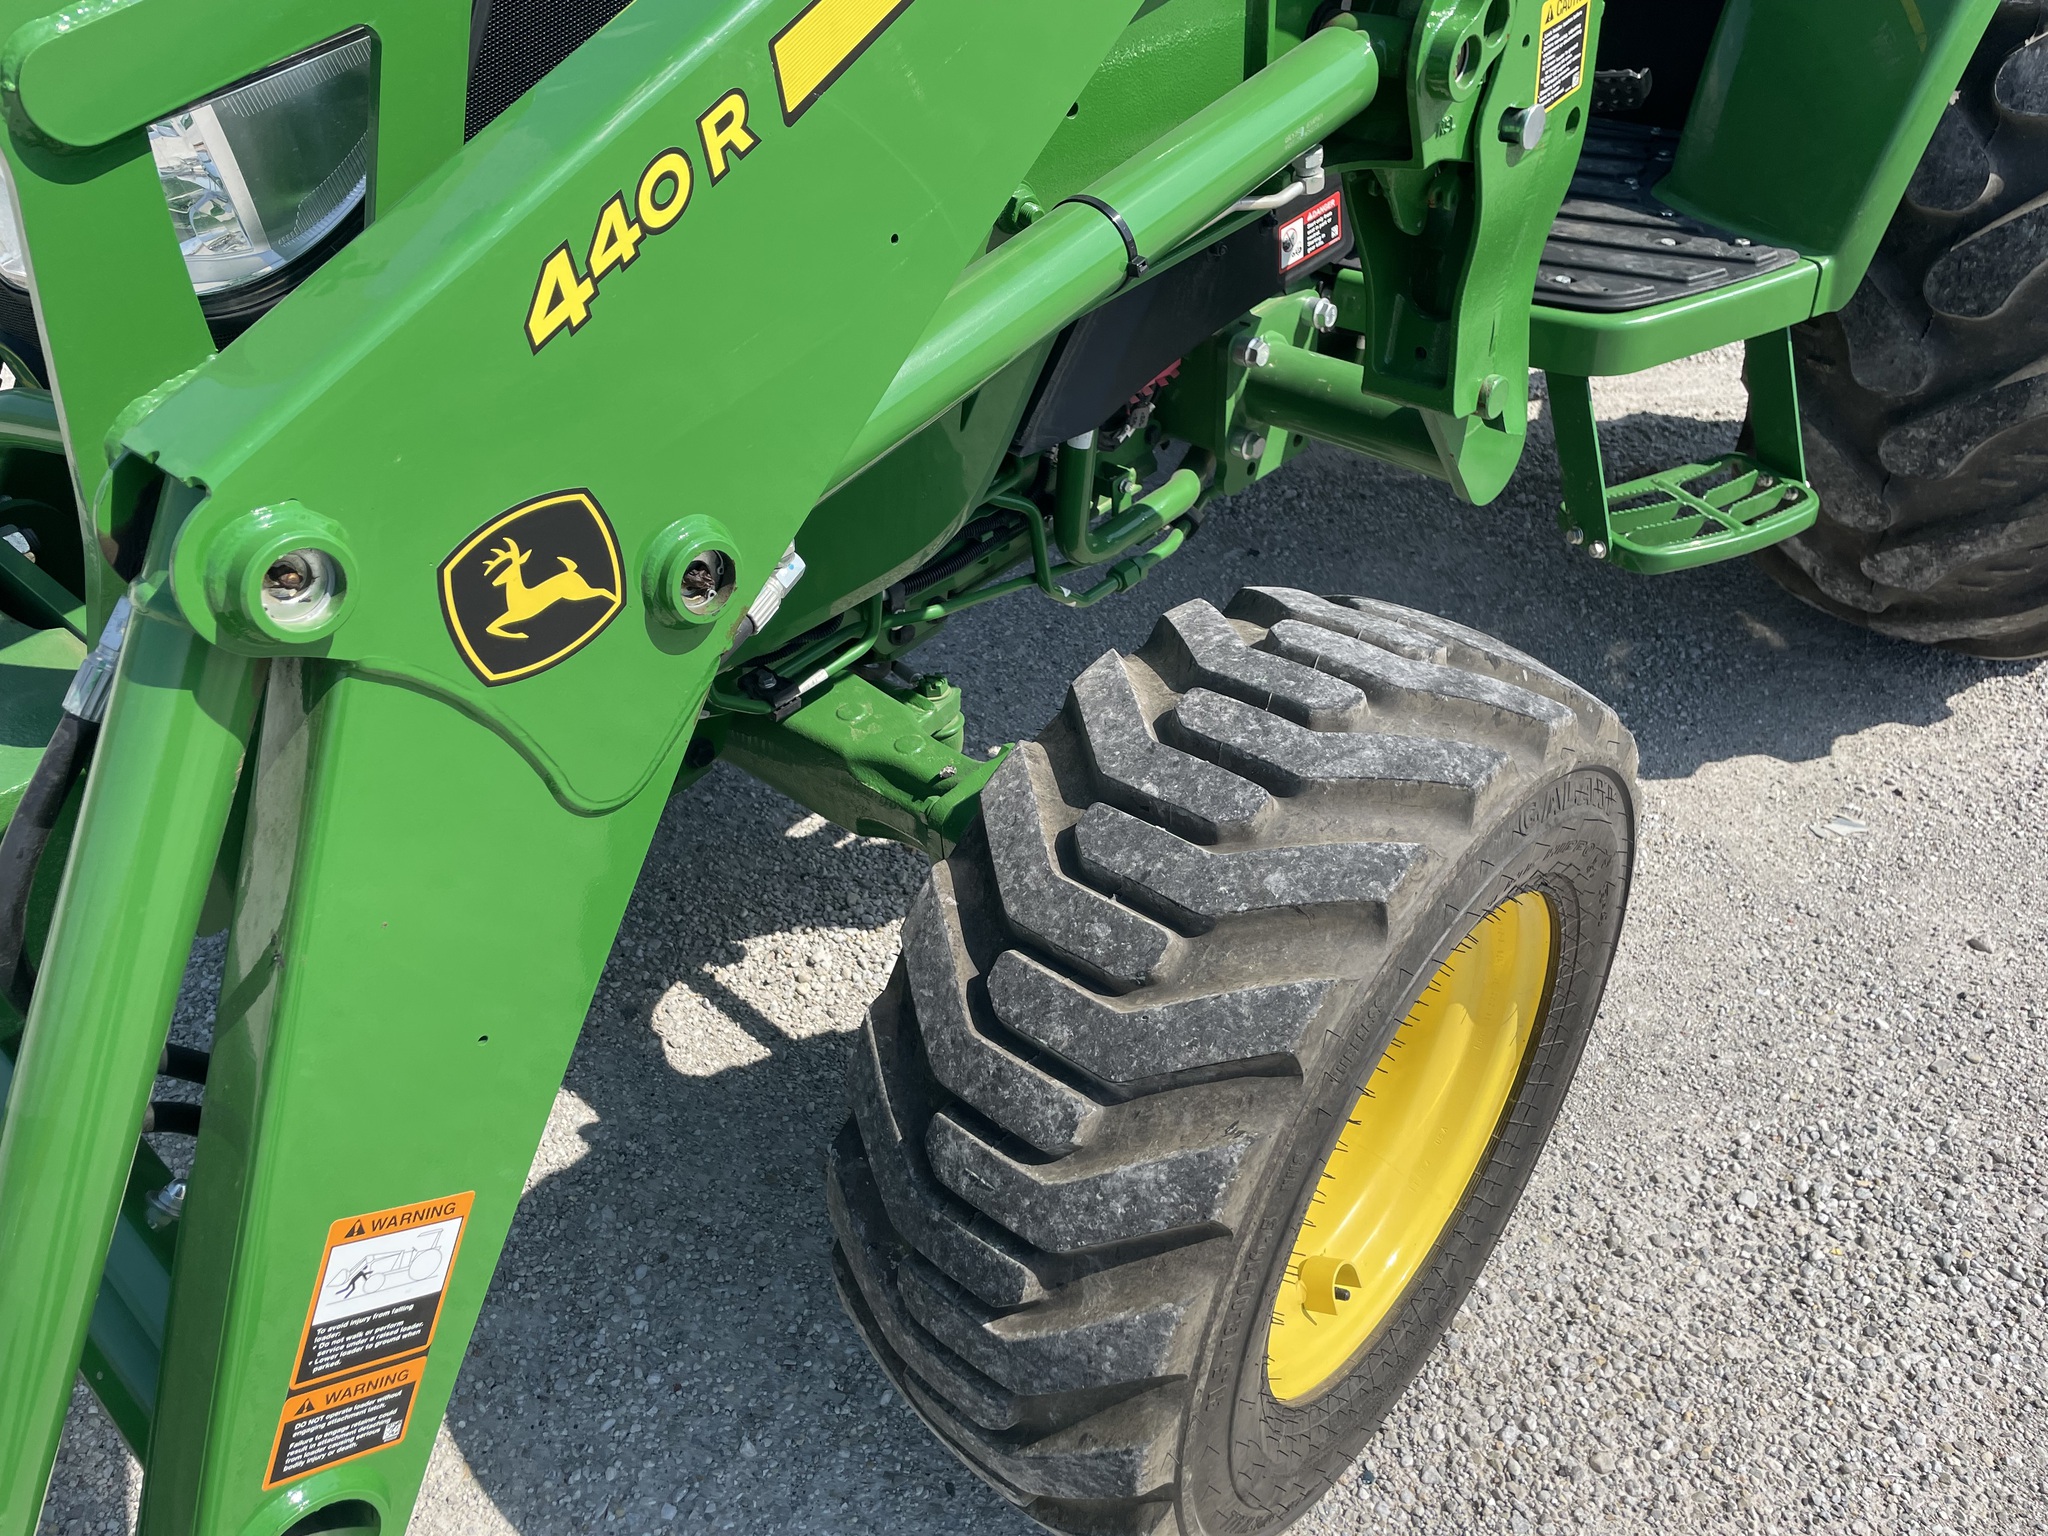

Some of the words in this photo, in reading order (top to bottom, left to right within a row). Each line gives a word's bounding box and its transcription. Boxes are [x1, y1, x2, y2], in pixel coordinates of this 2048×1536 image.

[371, 1202, 456, 1232] WARNING
[316, 1328, 325, 1336] To
[327, 1321, 349, 1333] avoid
[350, 1315, 371, 1327] injury
[372, 1310, 390, 1320] from
[391, 1304, 415, 1315] falling
[318, 1342, 330, 1350] Do
[331, 1336, 345, 1346] not
[345, 1331, 364, 1342] walk
[365, 1328, 374, 1336] or
[374, 1320, 404, 1335] perform
[314, 1353, 338, 1365] Lower
[339, 1346, 365, 1358] loader
[365, 1341, 374, 1350] to
[374, 1334, 401, 1349] ground
[402, 1329, 422, 1340] when
[316, 1345, 345, 1357] service
[346, 1337, 369, 1348] under
[375, 1329, 399, 1340] raised
[311, 1359, 342, 1374] parked.
[325, 1369, 409, 1405] WARNING
[292, 1423, 326, 1438] engaging
[326, 1408, 367, 1427] attachment
[294, 1420, 307, 1431] DO
[308, 1414, 326, 1426] NOT
[325, 1406, 353, 1420] operate
[353, 1398, 376, 1411] loader
[376, 1389, 403, 1404] without
[286, 1446, 308, 1457] result
[316, 1429, 357, 1447] attachment
[357, 1418, 391, 1433] detaching
[288, 1437, 314, 1450] Failure
[323, 1424, 350, 1438] engage
[350, 1416, 378, 1429] retainer
[378, 1407, 399, 1419] could
[282, 1460, 306, 1472] bodily
[306, 1452, 327, 1464] injury
[327, 1449, 336, 1457] or
[285, 1454, 303, 1465] from
[303, 1446, 326, 1458] loader
[327, 1437, 355, 1450] causing
[355, 1428, 381, 1440] serious
